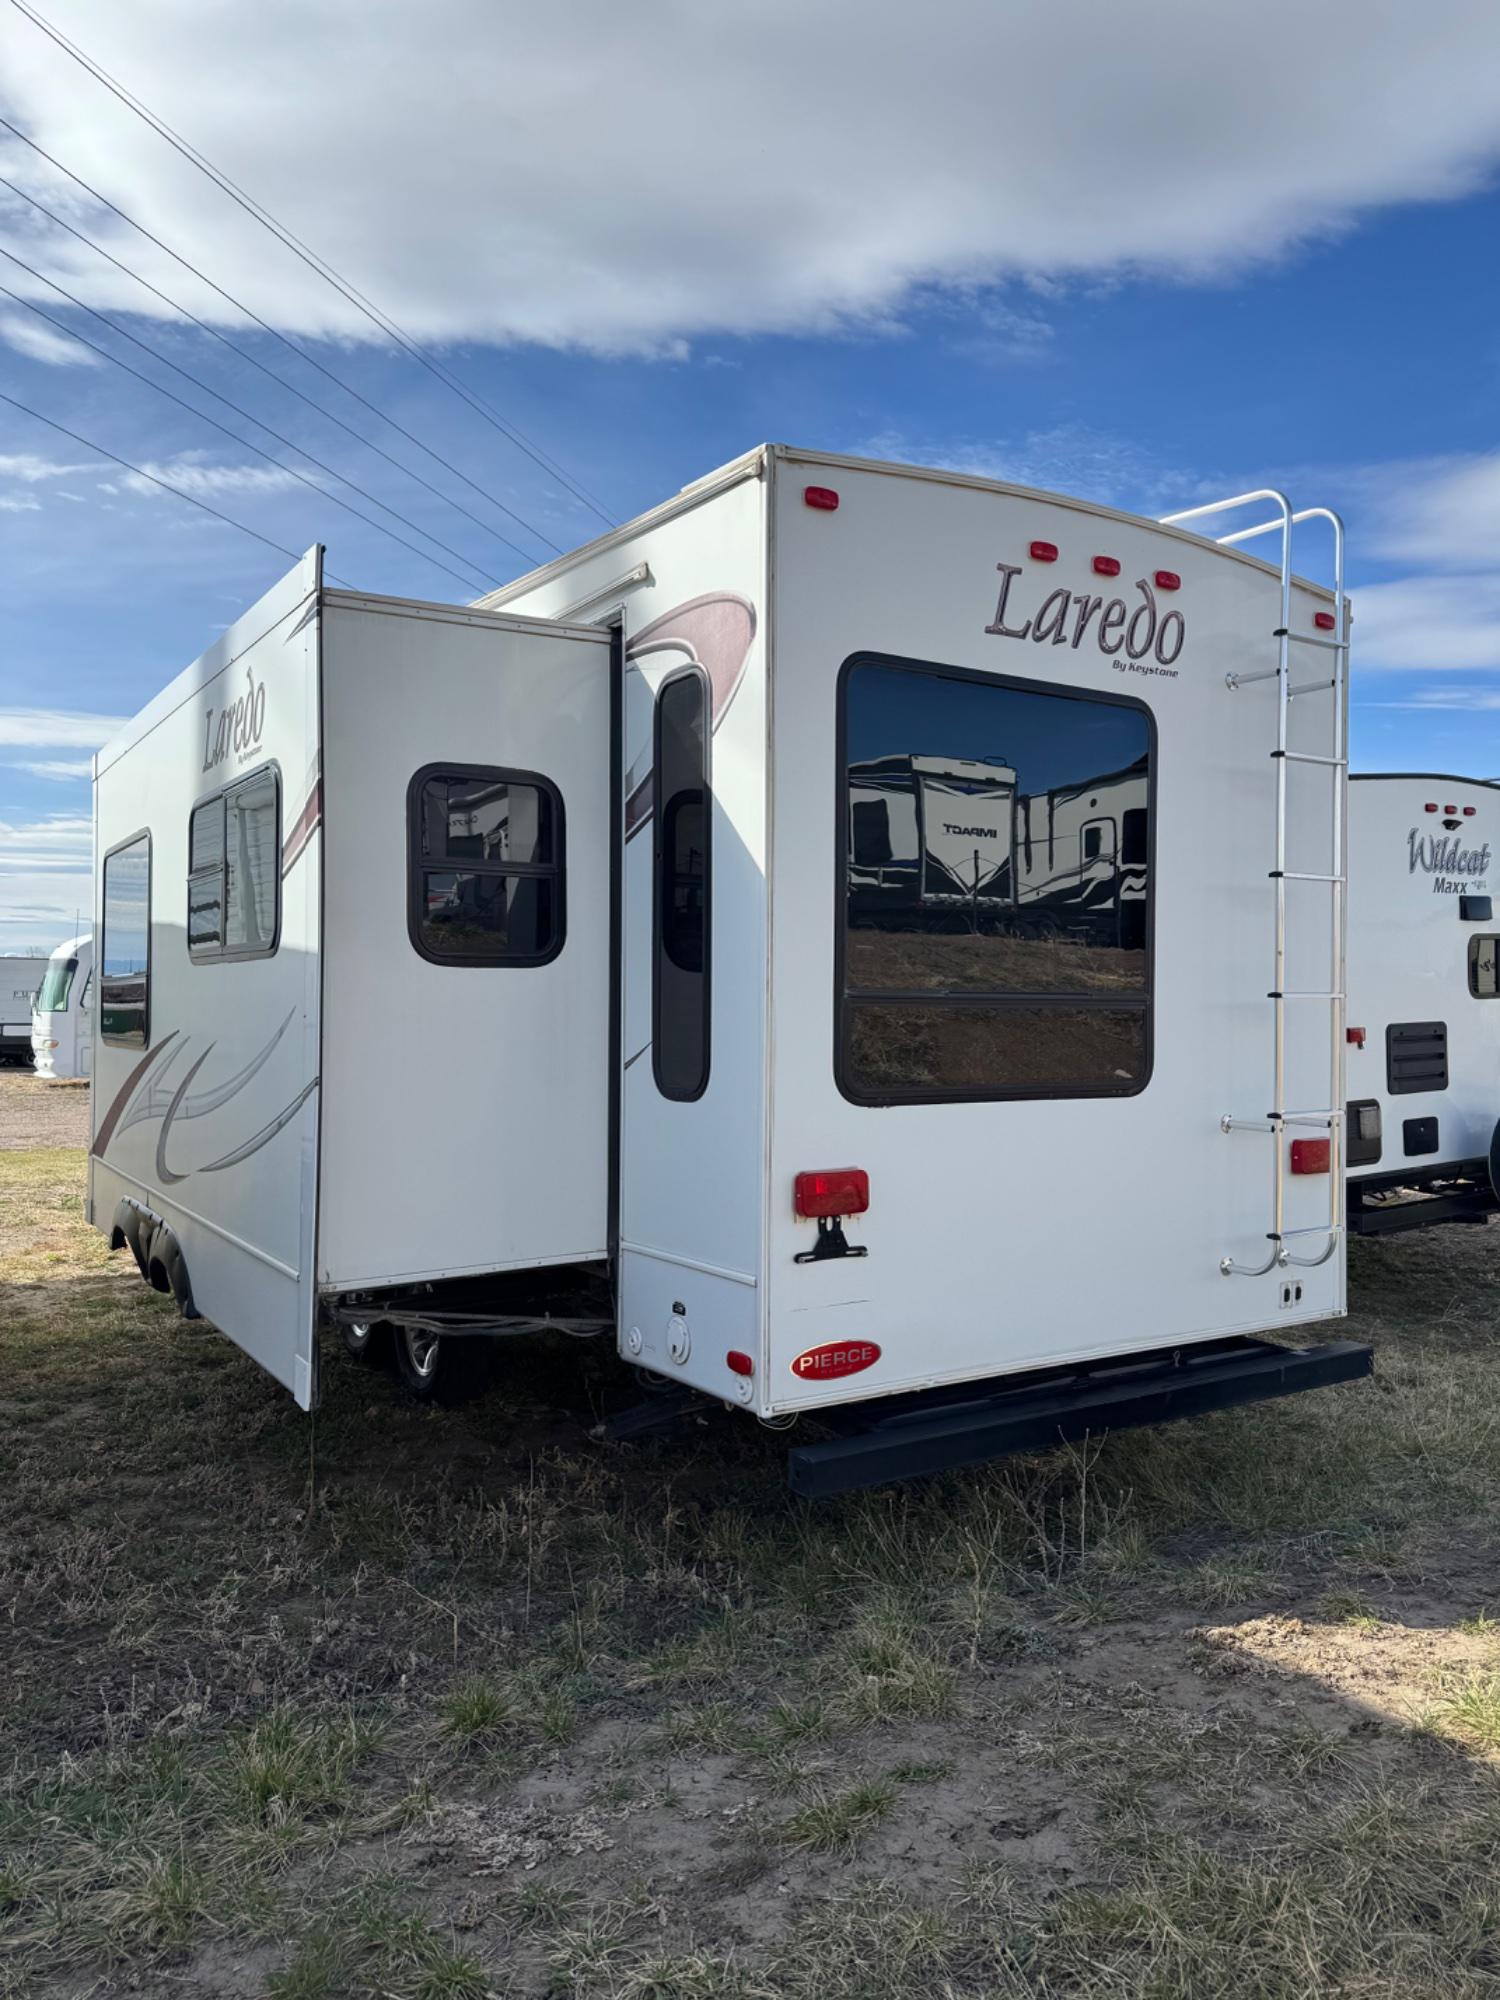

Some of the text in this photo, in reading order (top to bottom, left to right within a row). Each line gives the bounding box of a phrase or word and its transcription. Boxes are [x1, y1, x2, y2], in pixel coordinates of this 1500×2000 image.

[984, 562, 1185, 665] Laredo
[1112, 659, 1179, 678] By Keystone
[202, 666, 265, 773] Laredo
[1407, 827, 1492, 876] Wildcat
[1433, 877, 1469, 894] Maxx
[800, 1346, 873, 1371] PIERCE
